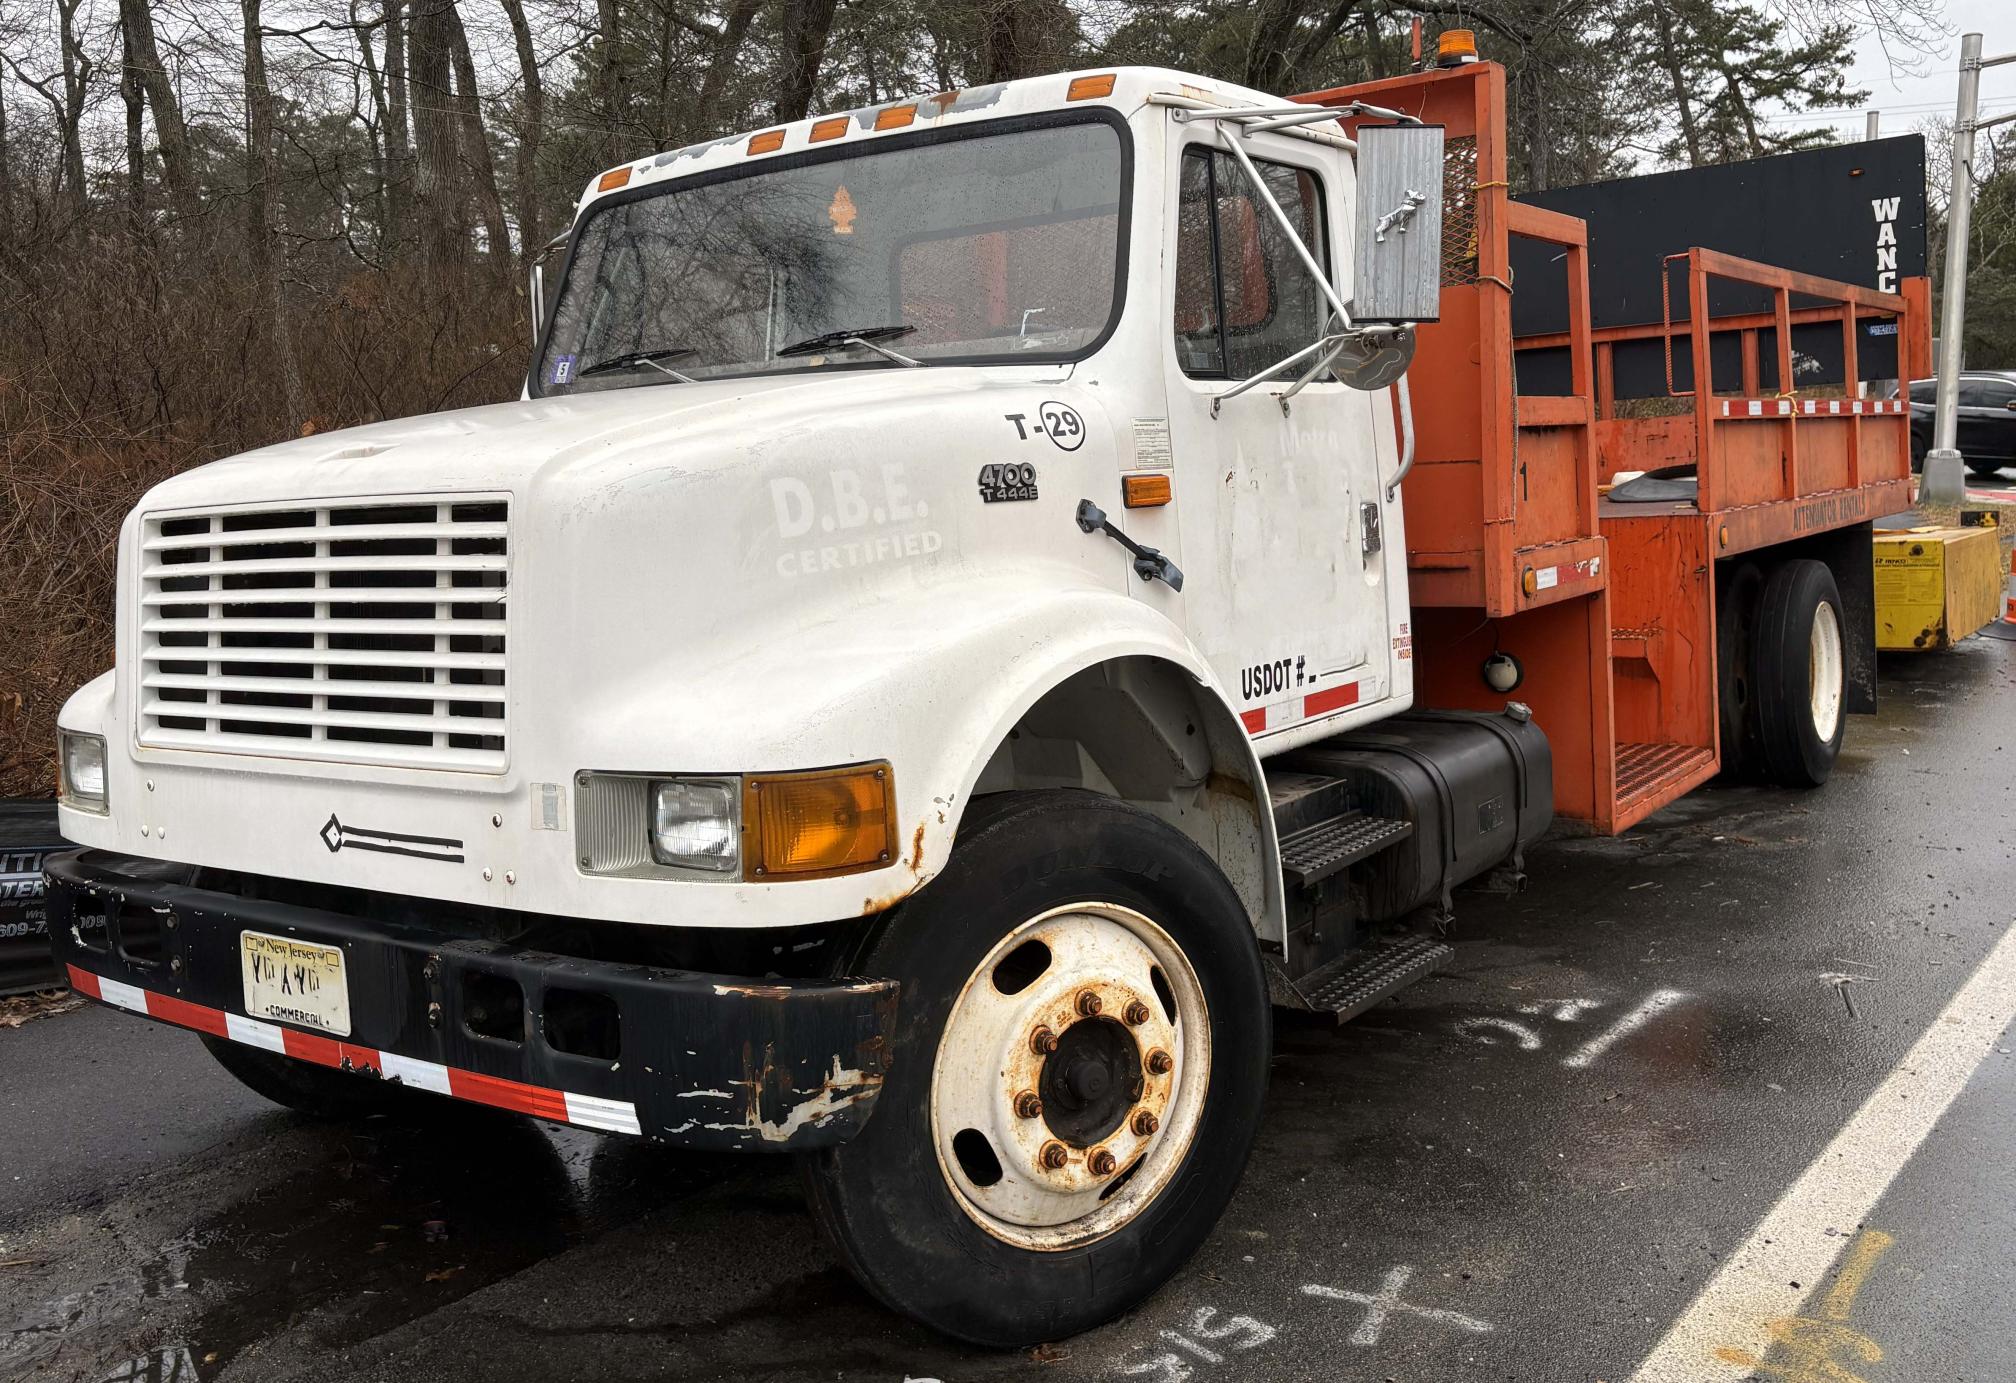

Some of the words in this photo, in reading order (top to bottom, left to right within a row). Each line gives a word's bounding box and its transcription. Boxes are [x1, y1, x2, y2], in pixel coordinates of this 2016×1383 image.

[979, 463, 1037, 487] 4700
[770, 462, 929, 538] D.B.E.
[996, 487, 1038, 500] 444E
[776, 530, 943, 577] CERTIFIED
[1242, 658, 1292, 700] USDOT
[0, 880, 44, 898] TER
[266, 938, 288, 955] New
[288, 943, 317, 963] Jersey
